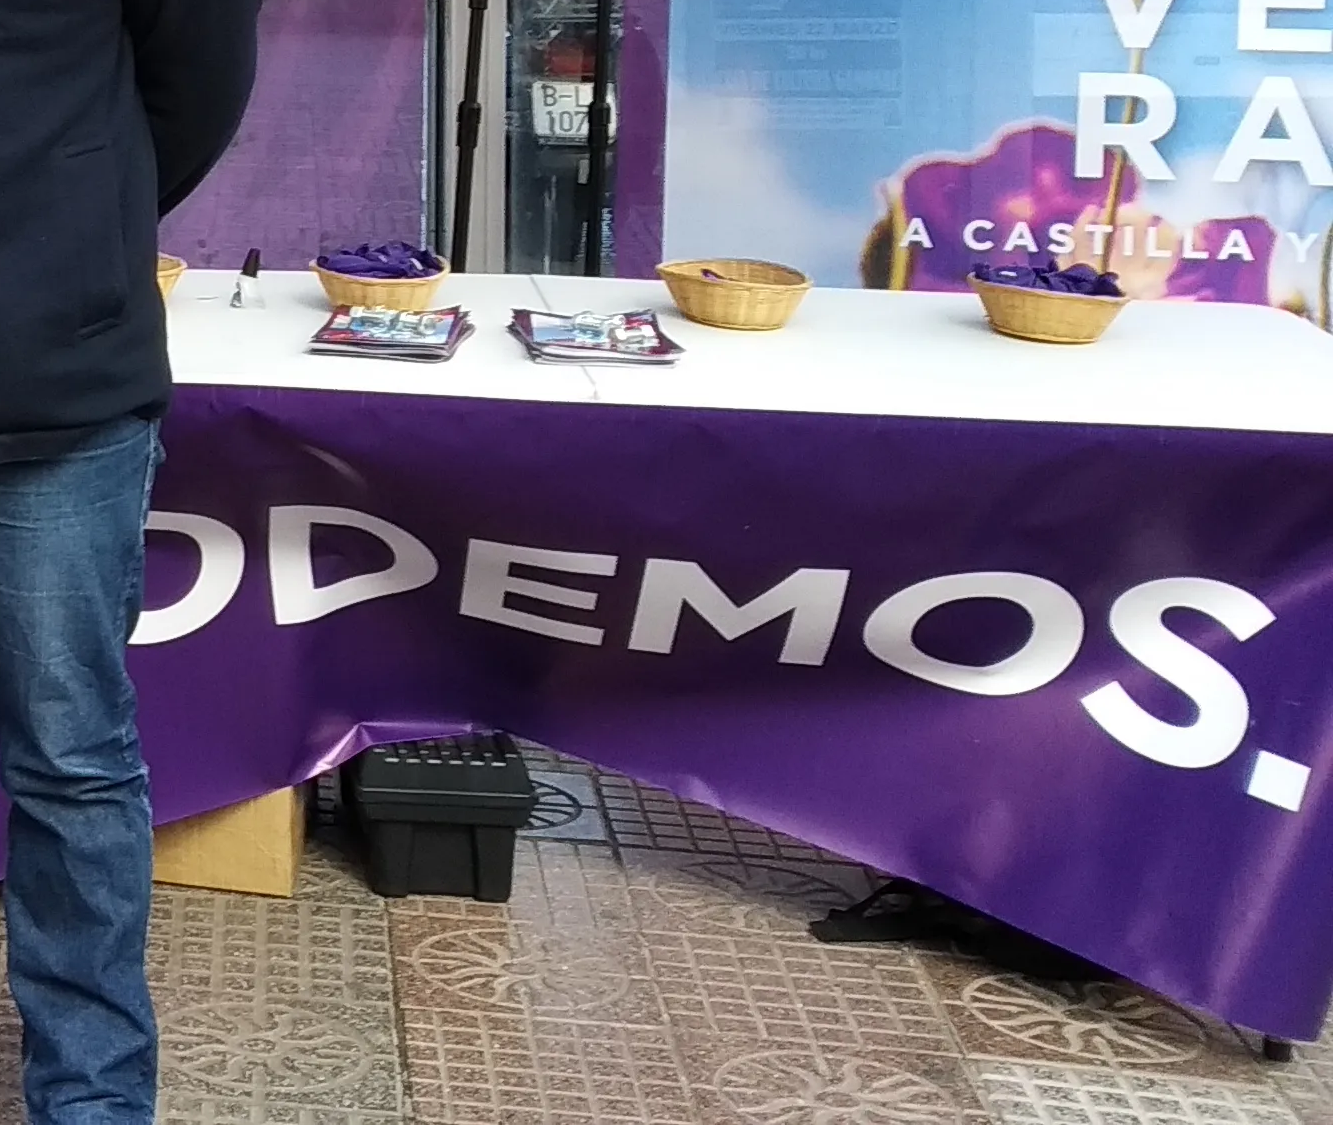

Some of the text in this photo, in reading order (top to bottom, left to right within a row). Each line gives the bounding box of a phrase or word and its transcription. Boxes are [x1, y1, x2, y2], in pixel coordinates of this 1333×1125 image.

[1074, 71, 1333, 187] RA
[900, 217, 1320, 263] A CASTILLA Y
